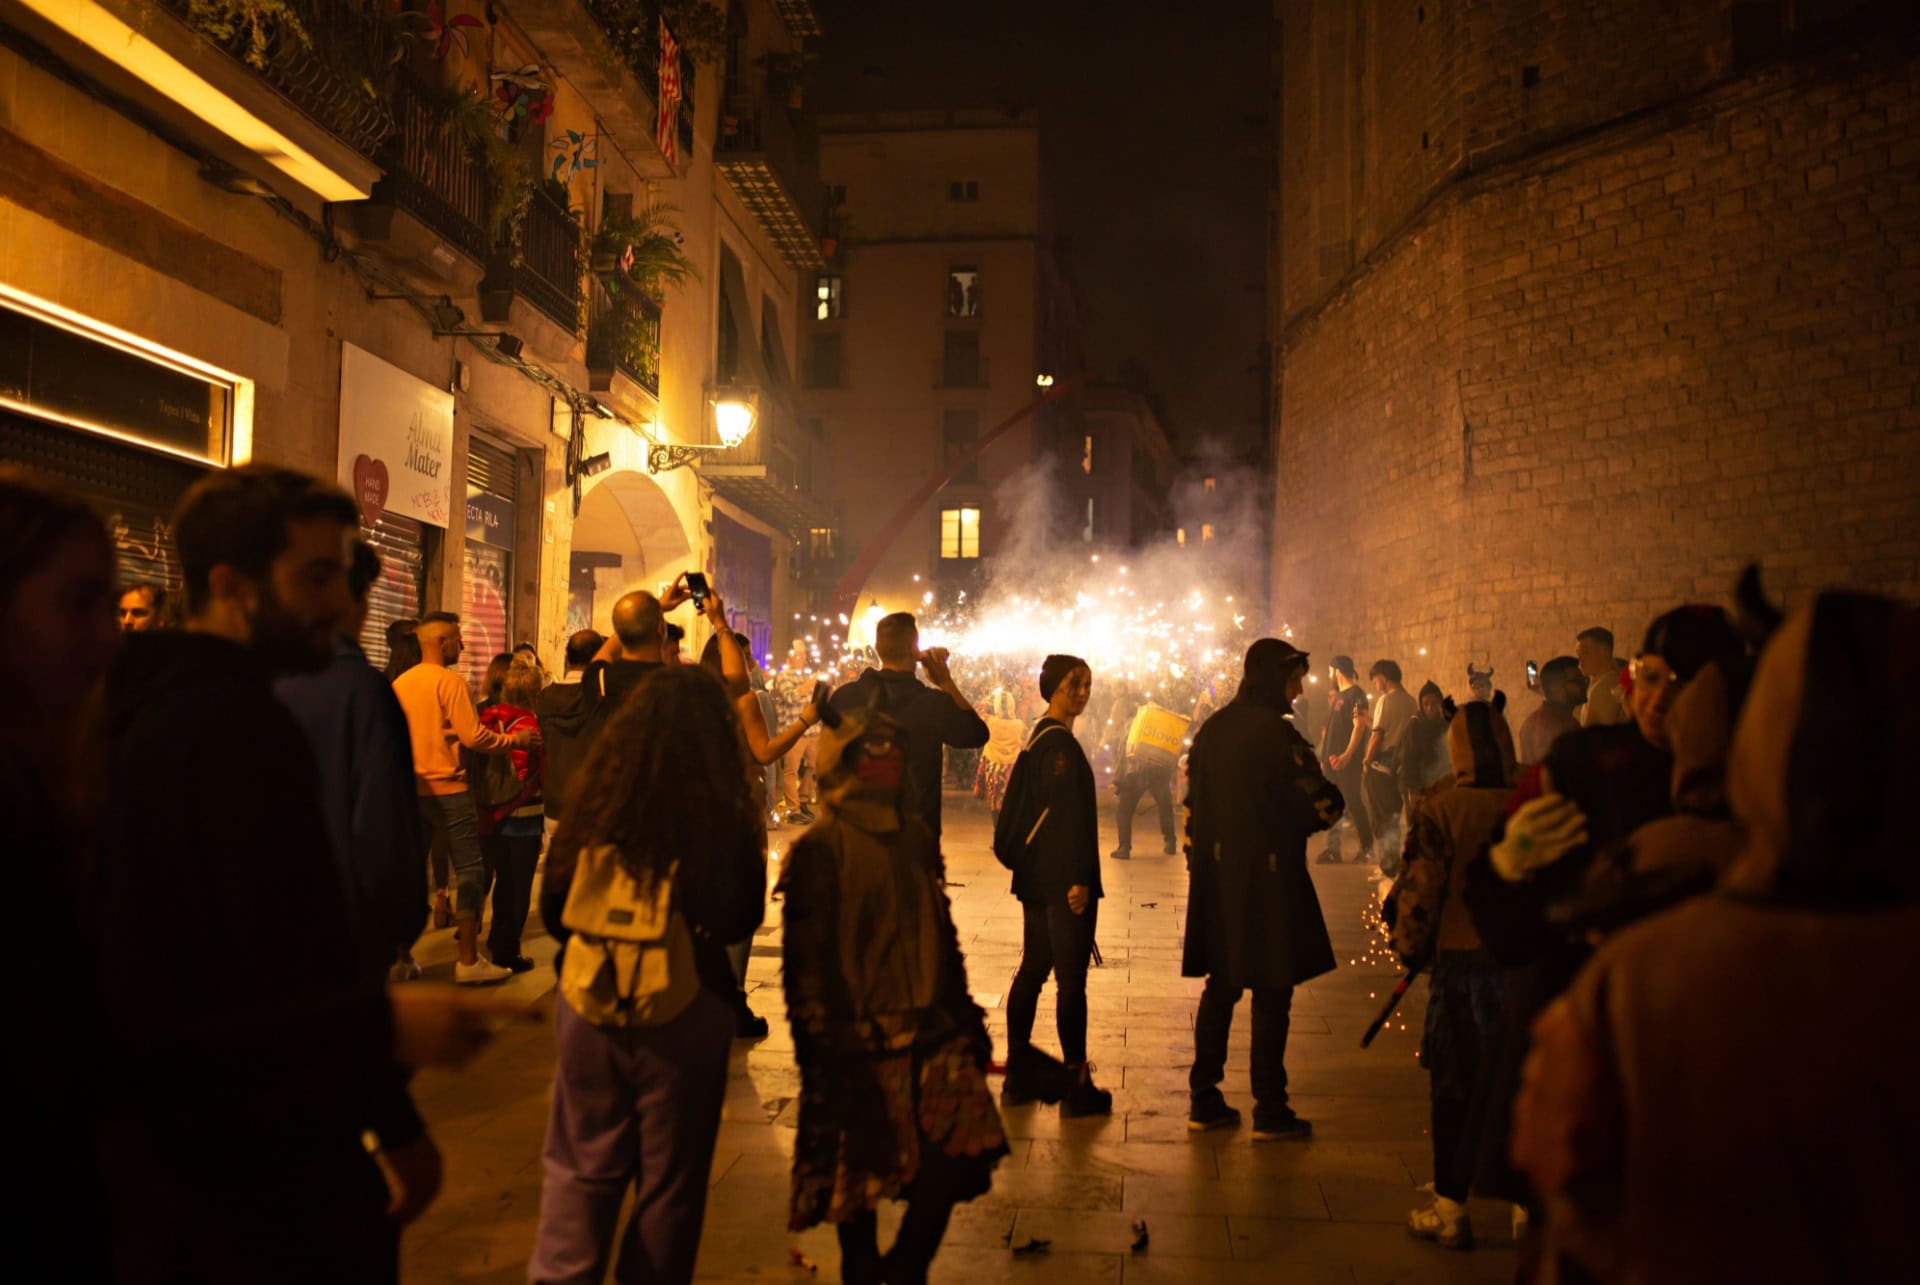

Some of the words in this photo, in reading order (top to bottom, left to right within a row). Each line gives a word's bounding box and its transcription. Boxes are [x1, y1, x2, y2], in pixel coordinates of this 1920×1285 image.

[406, 411, 440, 453] Alma
[404, 443, 442, 479] Mater
[365, 475, 381, 491] HAND
[364, 490, 380, 506] MADE
